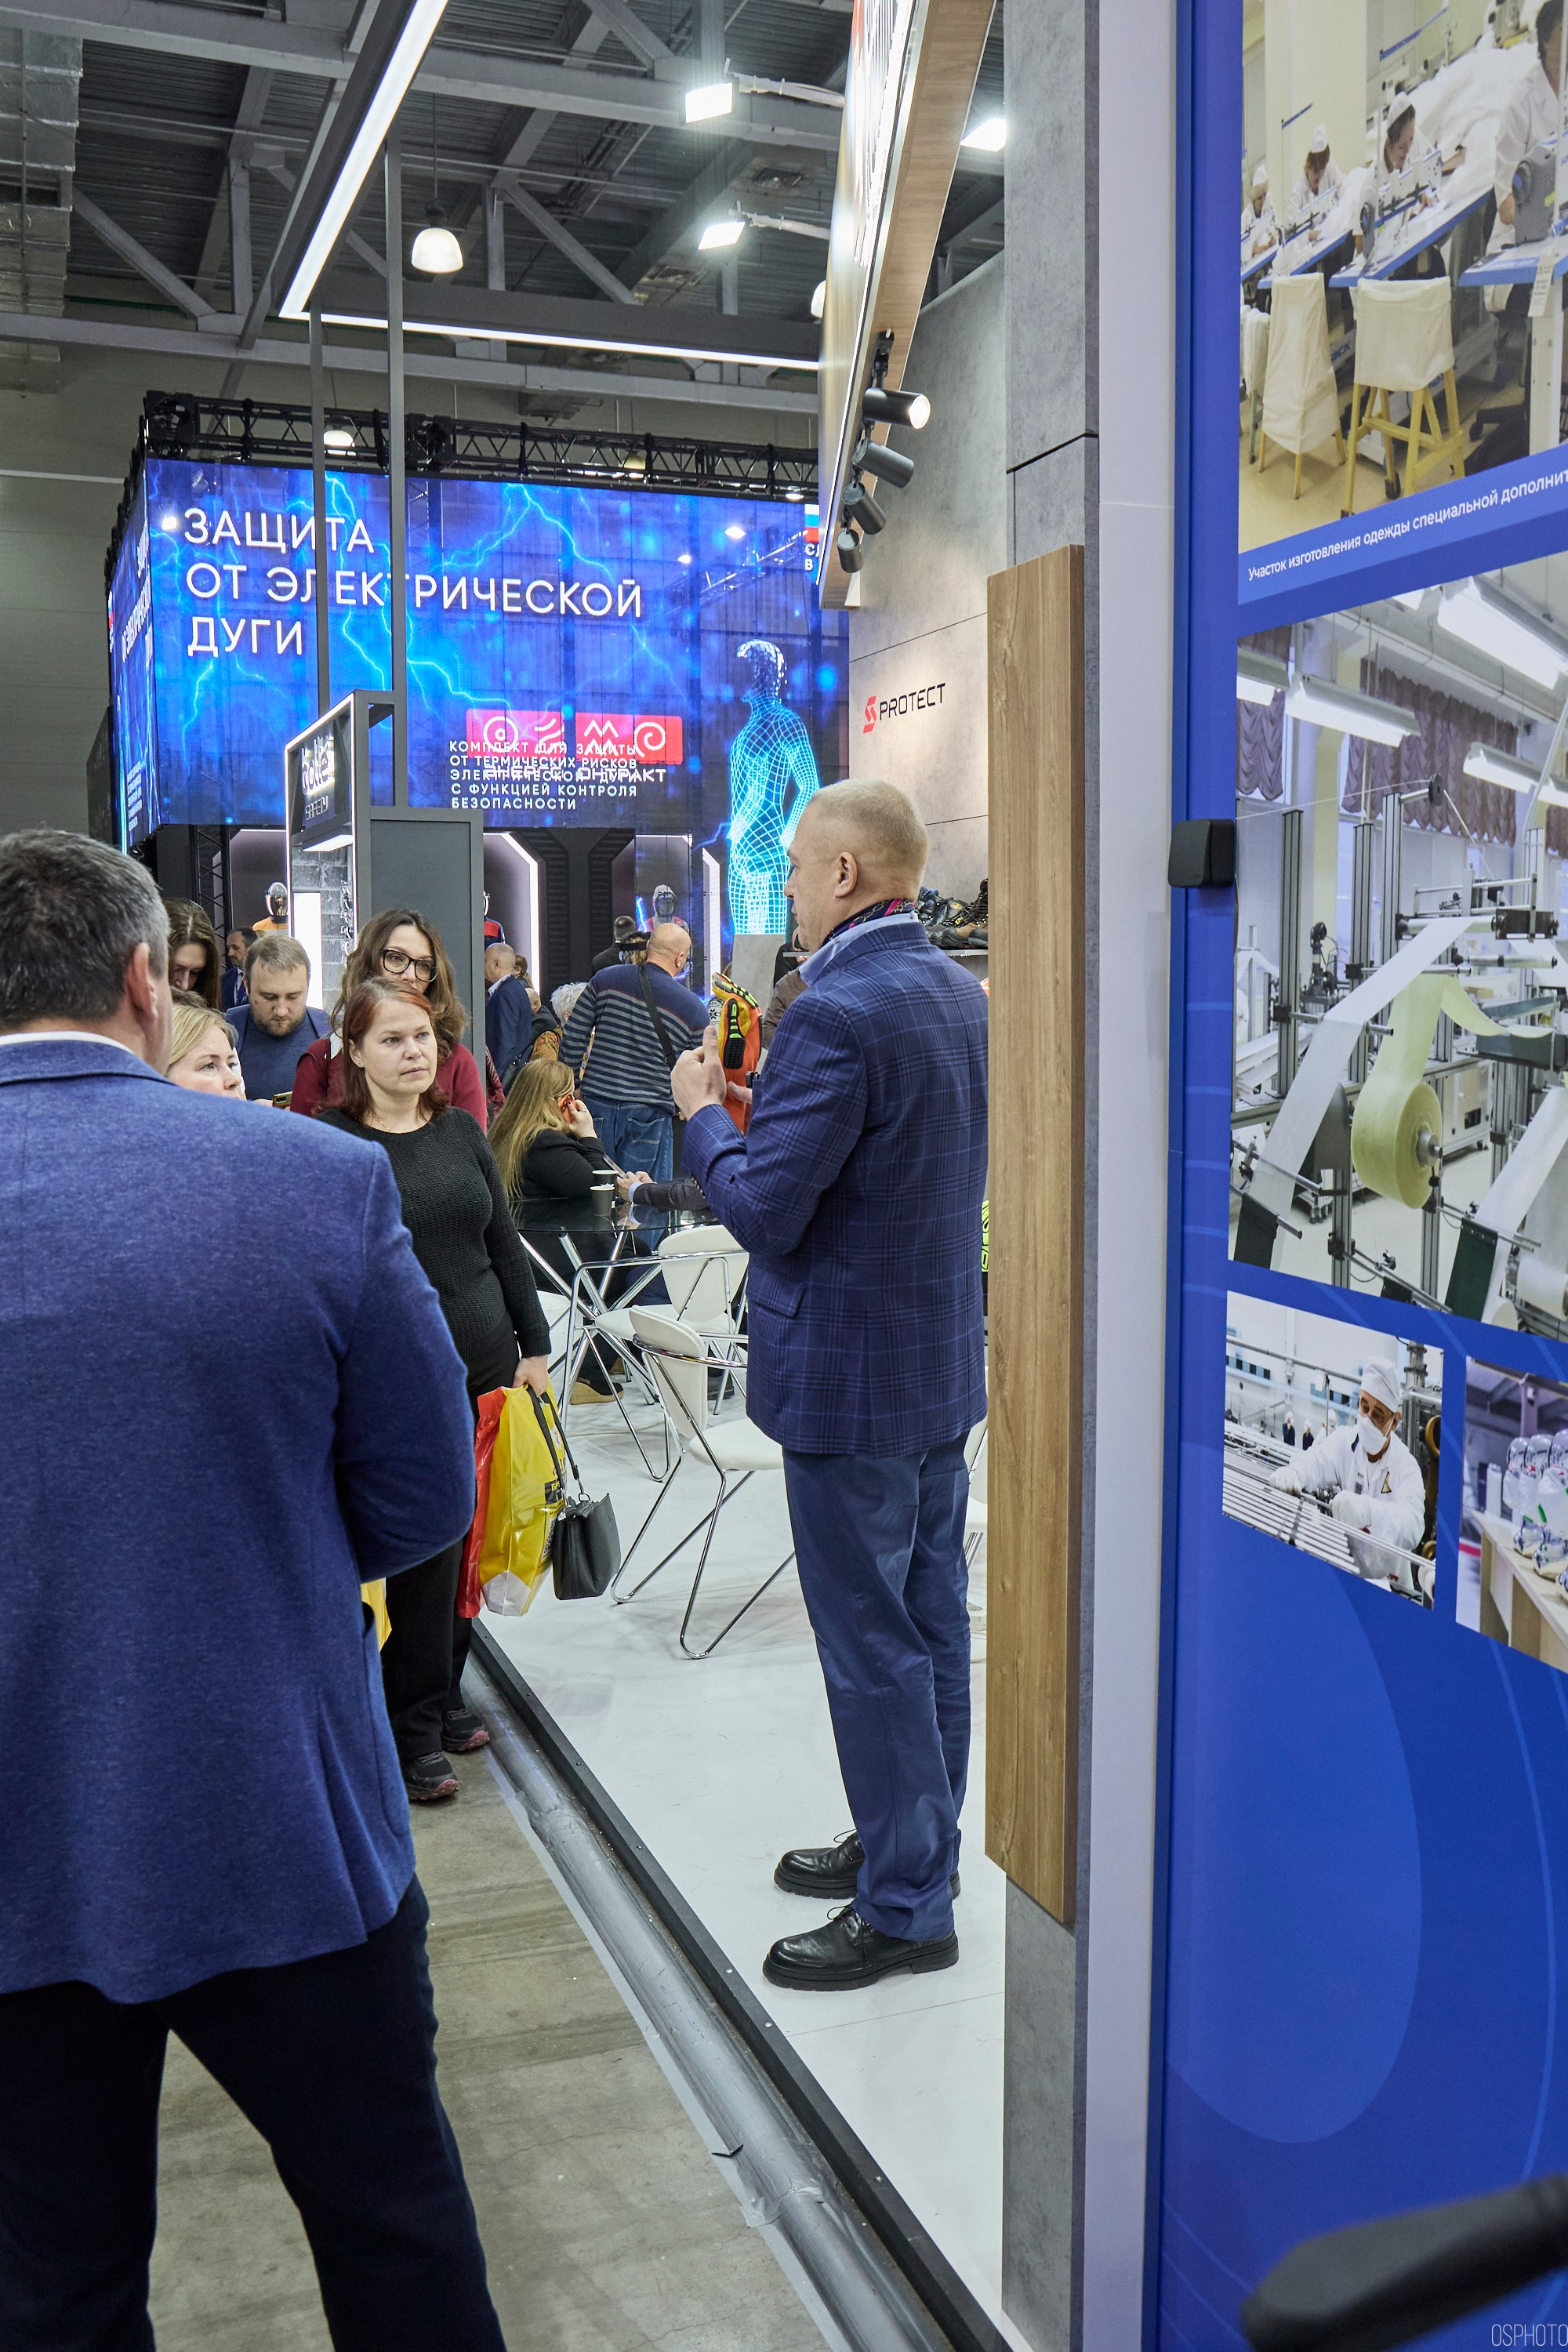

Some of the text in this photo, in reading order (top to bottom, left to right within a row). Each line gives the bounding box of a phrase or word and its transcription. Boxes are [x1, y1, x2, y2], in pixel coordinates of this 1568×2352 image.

[184, 508, 375, 554] ЗАЩИТА
[1248, 560, 1287, 582] Участок
[1289, 535, 1361, 569] изготовления
[1363, 521, 1410, 546] одежды
[1413, 488, 1498, 530] специальной
[186, 562, 641, 618] ОТ ЭЛЕКРИЧЕСКОЙ
[187, 616, 303, 658] ДУГИ
[880, 683, 946, 720] PROTECT
[449, 740, 529, 753] КОМПЛЕКТ
[538, 742, 567, 755] ДЛЯ
[449, 755, 637, 769] ОТ ТЕРМИЧЕСКИХ РИСКОВ
[451, 782, 637, 797] С ФУНКЦИЕЙ КОНТРОЛЯ
[452, 797, 576, 810] БЕЗОПАСНОСТИ
